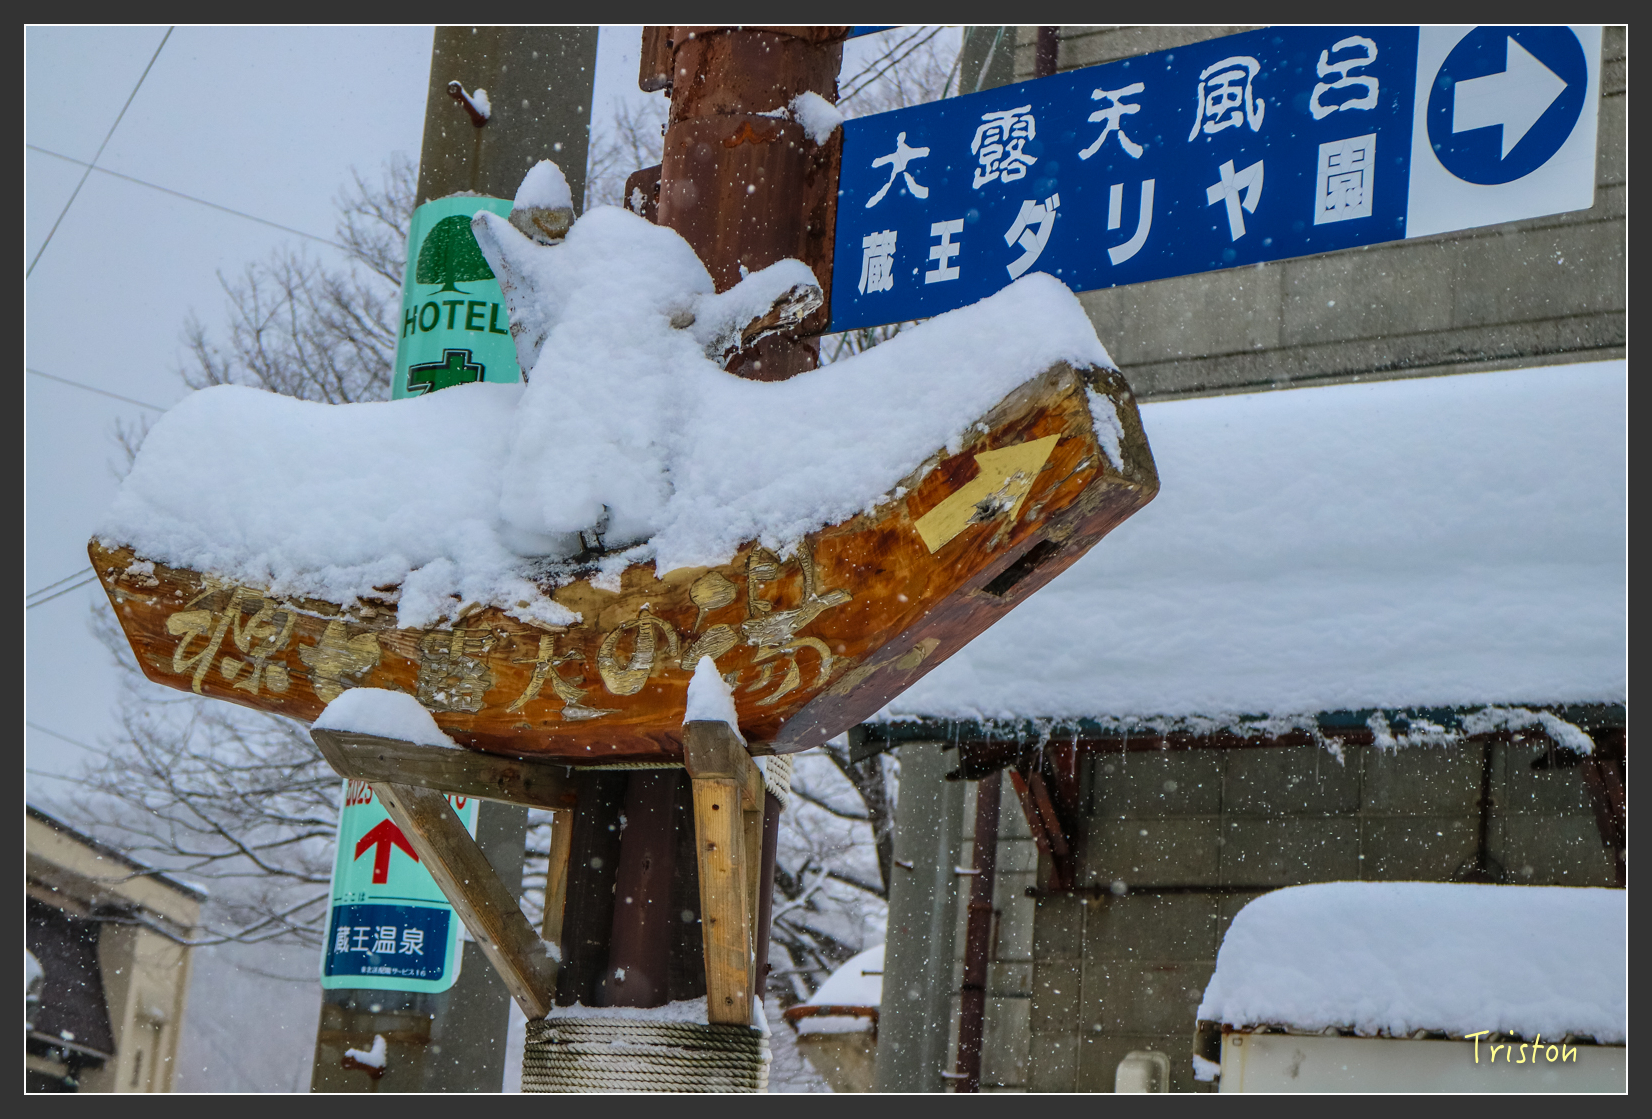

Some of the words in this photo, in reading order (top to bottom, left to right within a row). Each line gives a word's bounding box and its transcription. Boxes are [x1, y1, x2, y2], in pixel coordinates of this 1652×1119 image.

[865, 35, 1380, 209] 大露天風呂
[403, 300, 508, 338] HOTEL
[333, 925, 424, 956] 蔵王温泉
